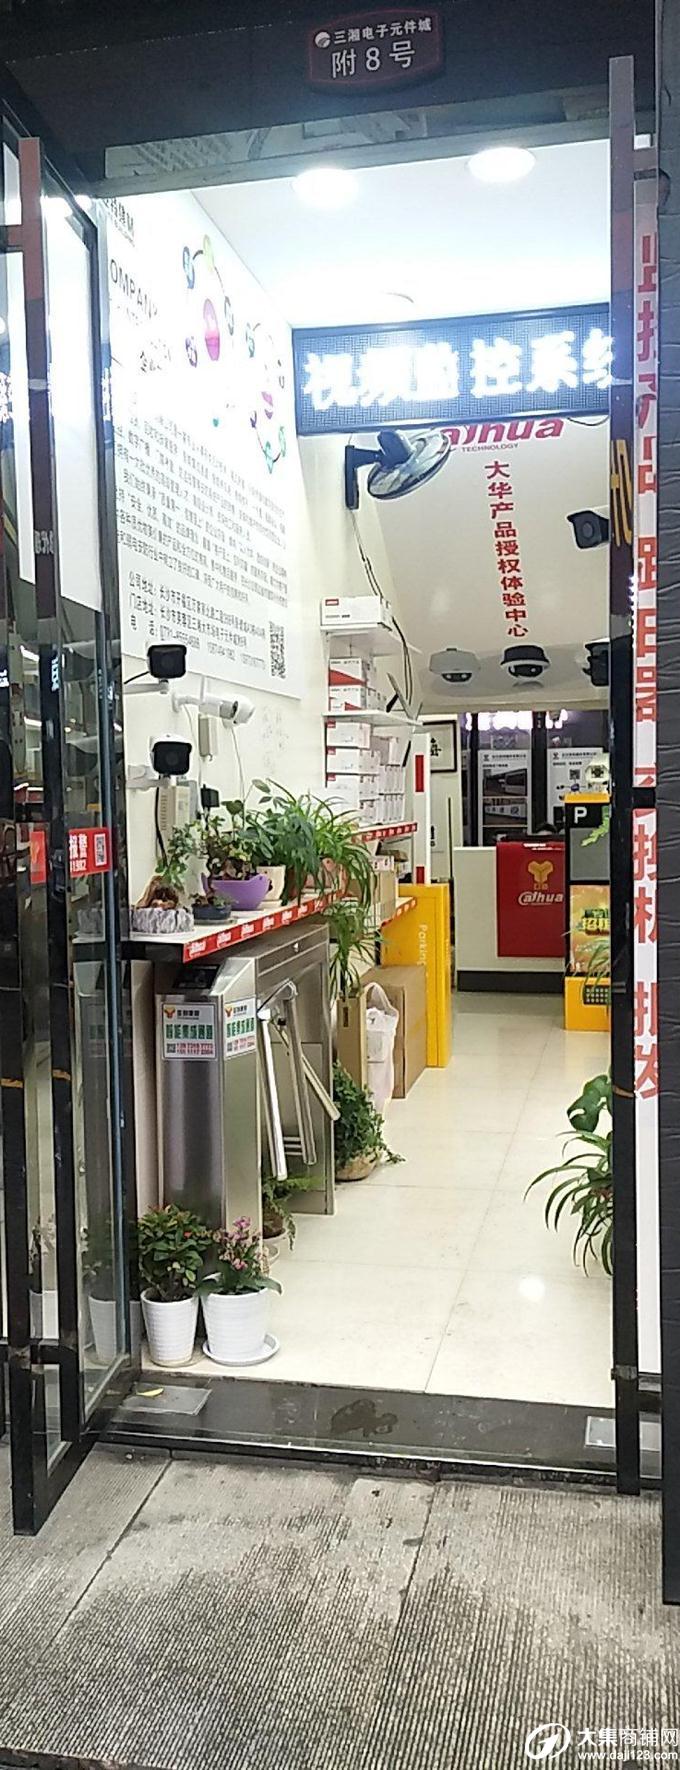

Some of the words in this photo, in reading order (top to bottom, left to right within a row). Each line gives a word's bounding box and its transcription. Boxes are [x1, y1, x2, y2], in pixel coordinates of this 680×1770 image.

[333, 17, 432, 45] 三湘电子元件城
[331, 41, 415, 78] 附8号
[462, 443, 519, 452] TECHNOLOGY
[484, 461, 528, 638] 大华产品授权体验中心
[573, 806, 588, 824] P
